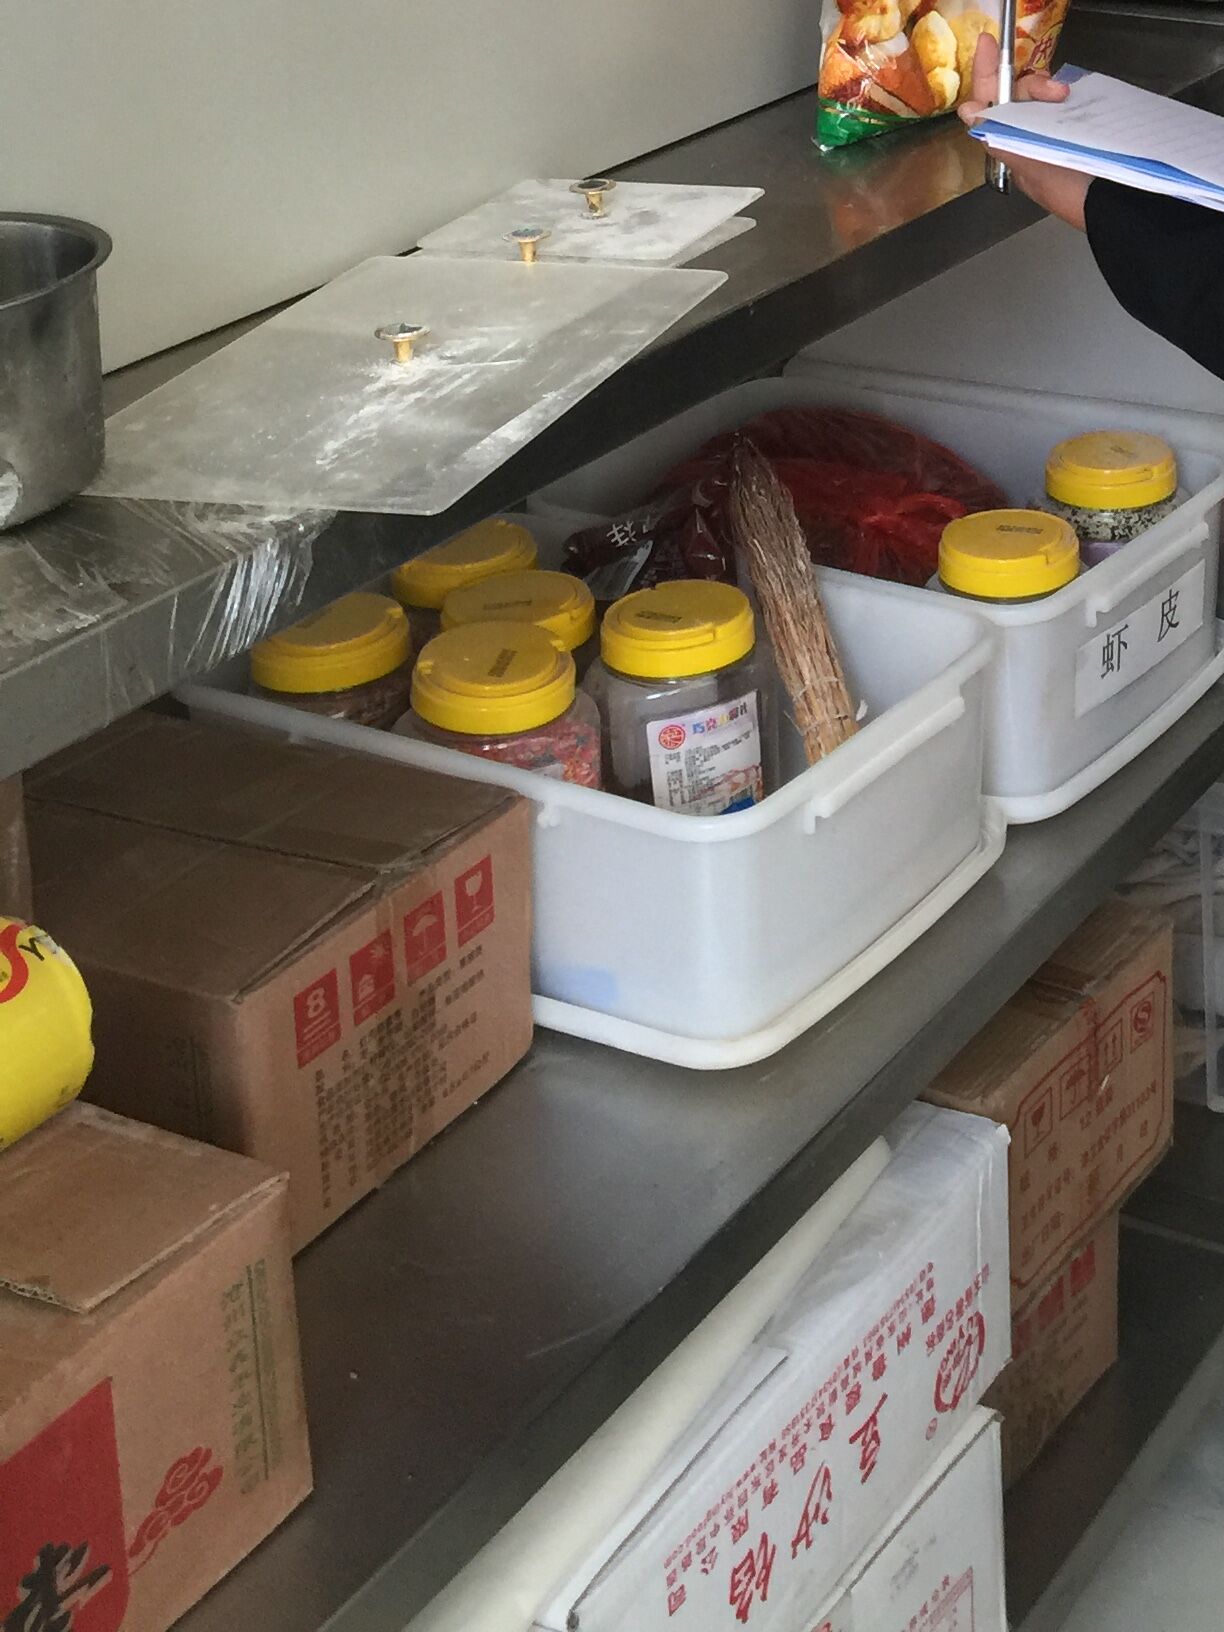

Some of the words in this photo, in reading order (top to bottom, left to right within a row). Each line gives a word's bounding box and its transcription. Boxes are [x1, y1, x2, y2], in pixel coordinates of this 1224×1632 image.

[1099, 588, 1180, 680] 虾皮
[729, 1392, 888, 1625] 豆沙馅
